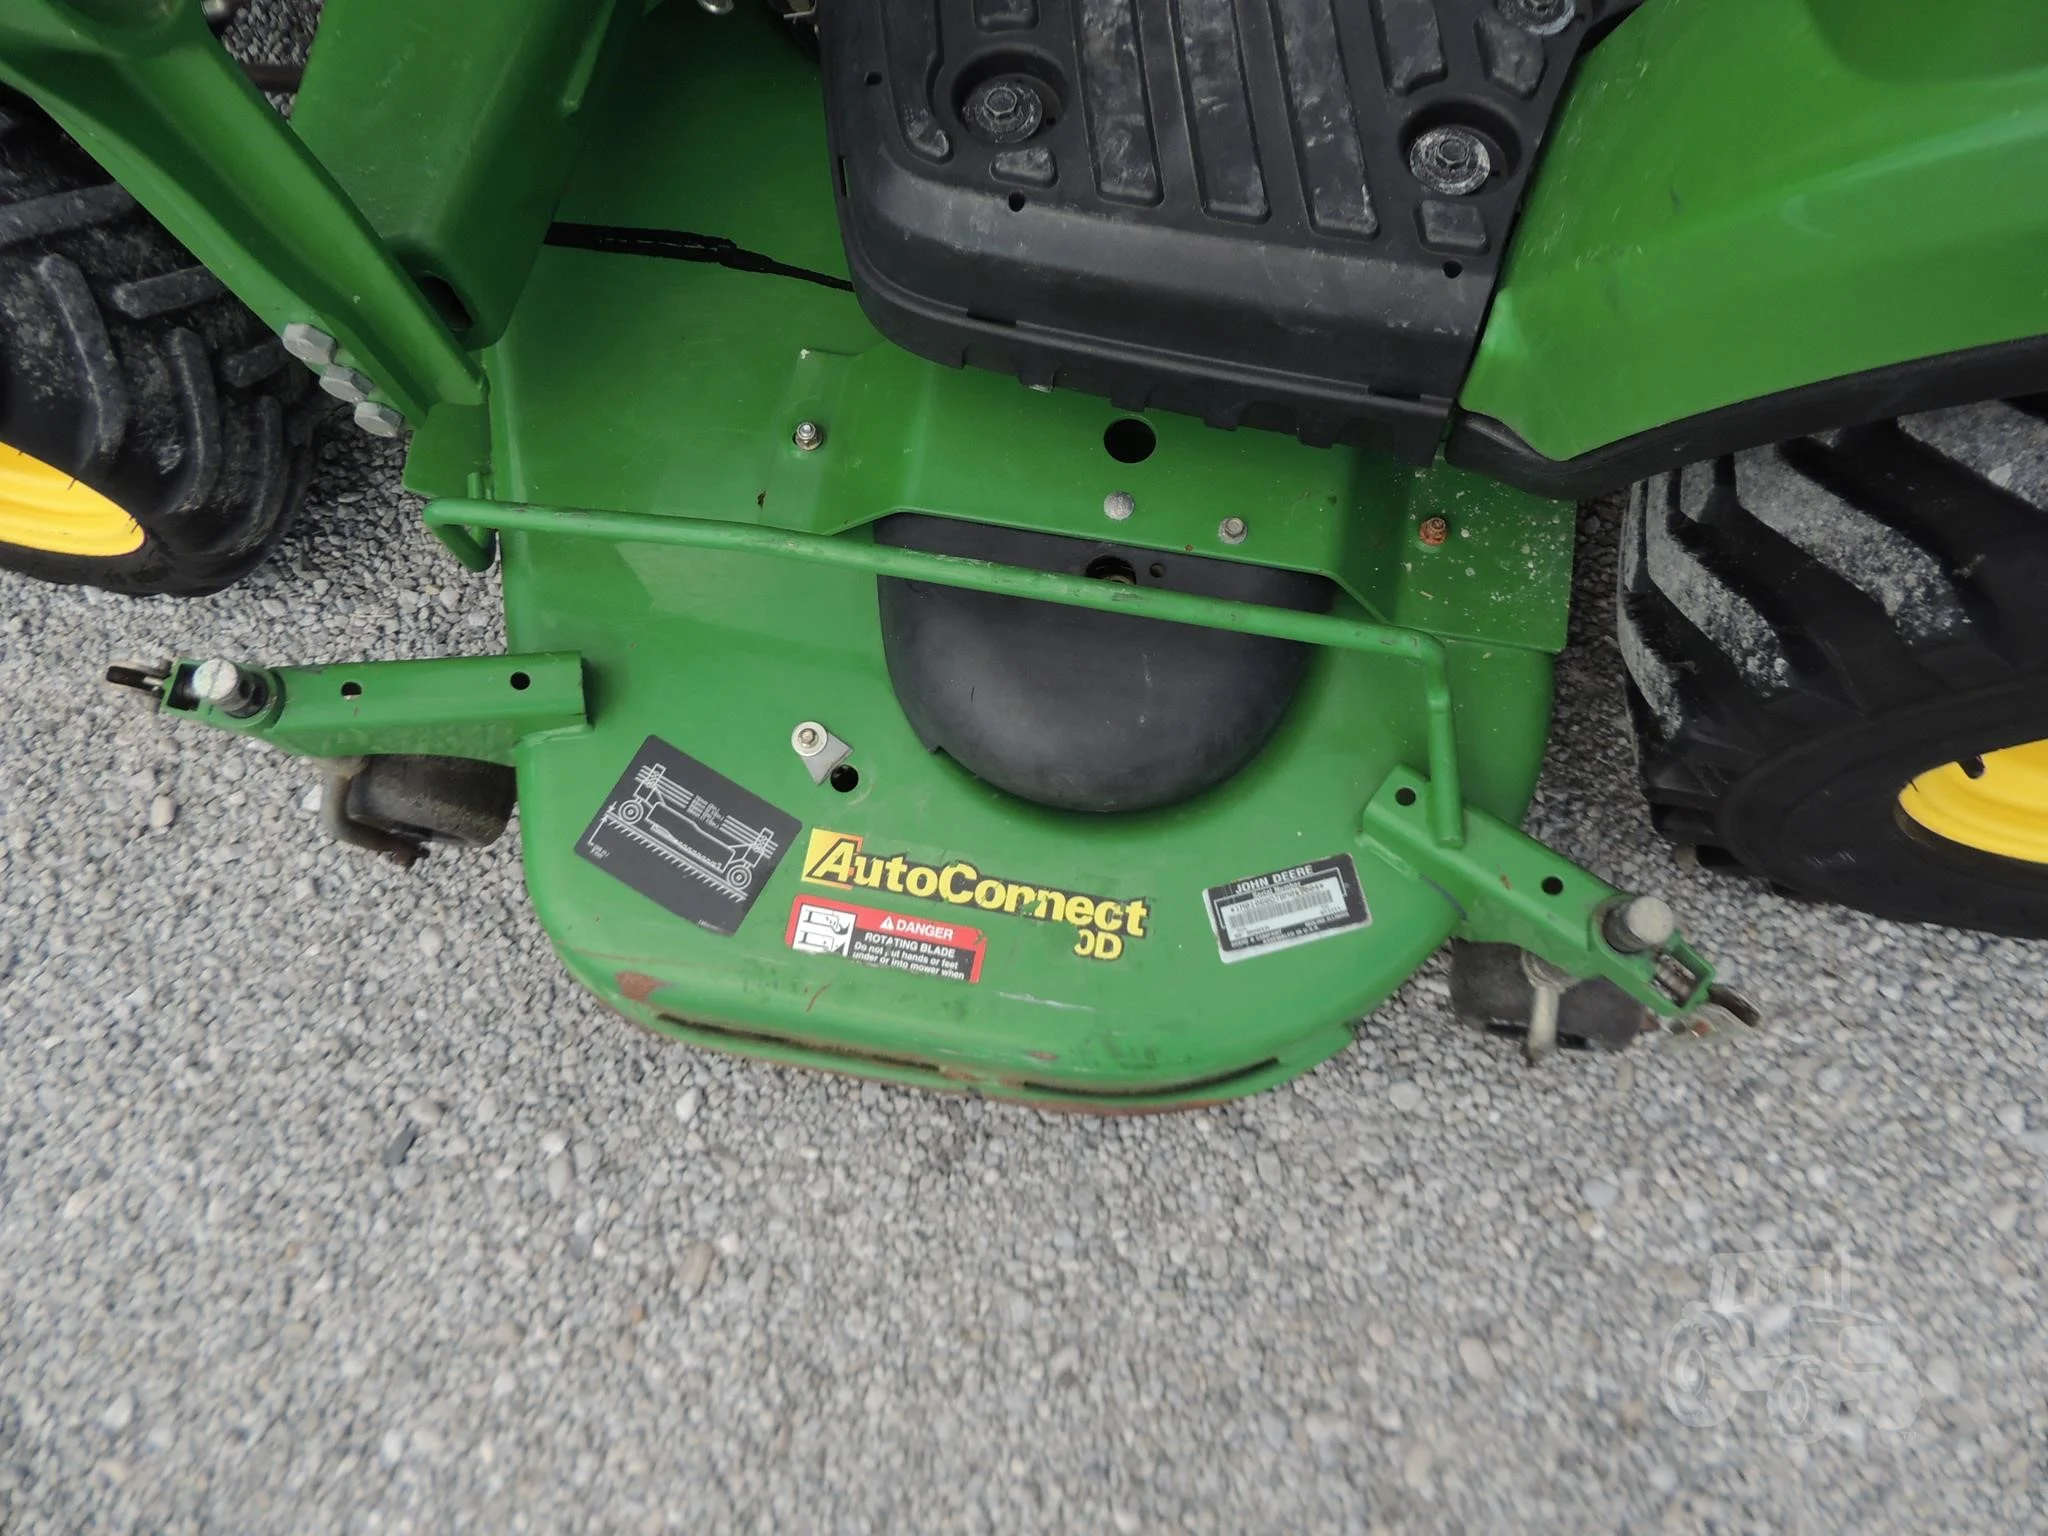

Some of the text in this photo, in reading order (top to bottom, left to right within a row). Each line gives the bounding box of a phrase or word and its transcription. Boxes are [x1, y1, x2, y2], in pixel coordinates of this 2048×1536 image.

[808, 840, 1148, 937] AutoConnect
[1235, 865, 1313, 894] JOHN DEERE
[896, 919, 954, 940] DANGER
[854, 942, 958, 970] Do not ut hands or feet
[865, 932, 956, 958] ROTATING BLADE
[853, 951, 965, 980] under or into mower when
